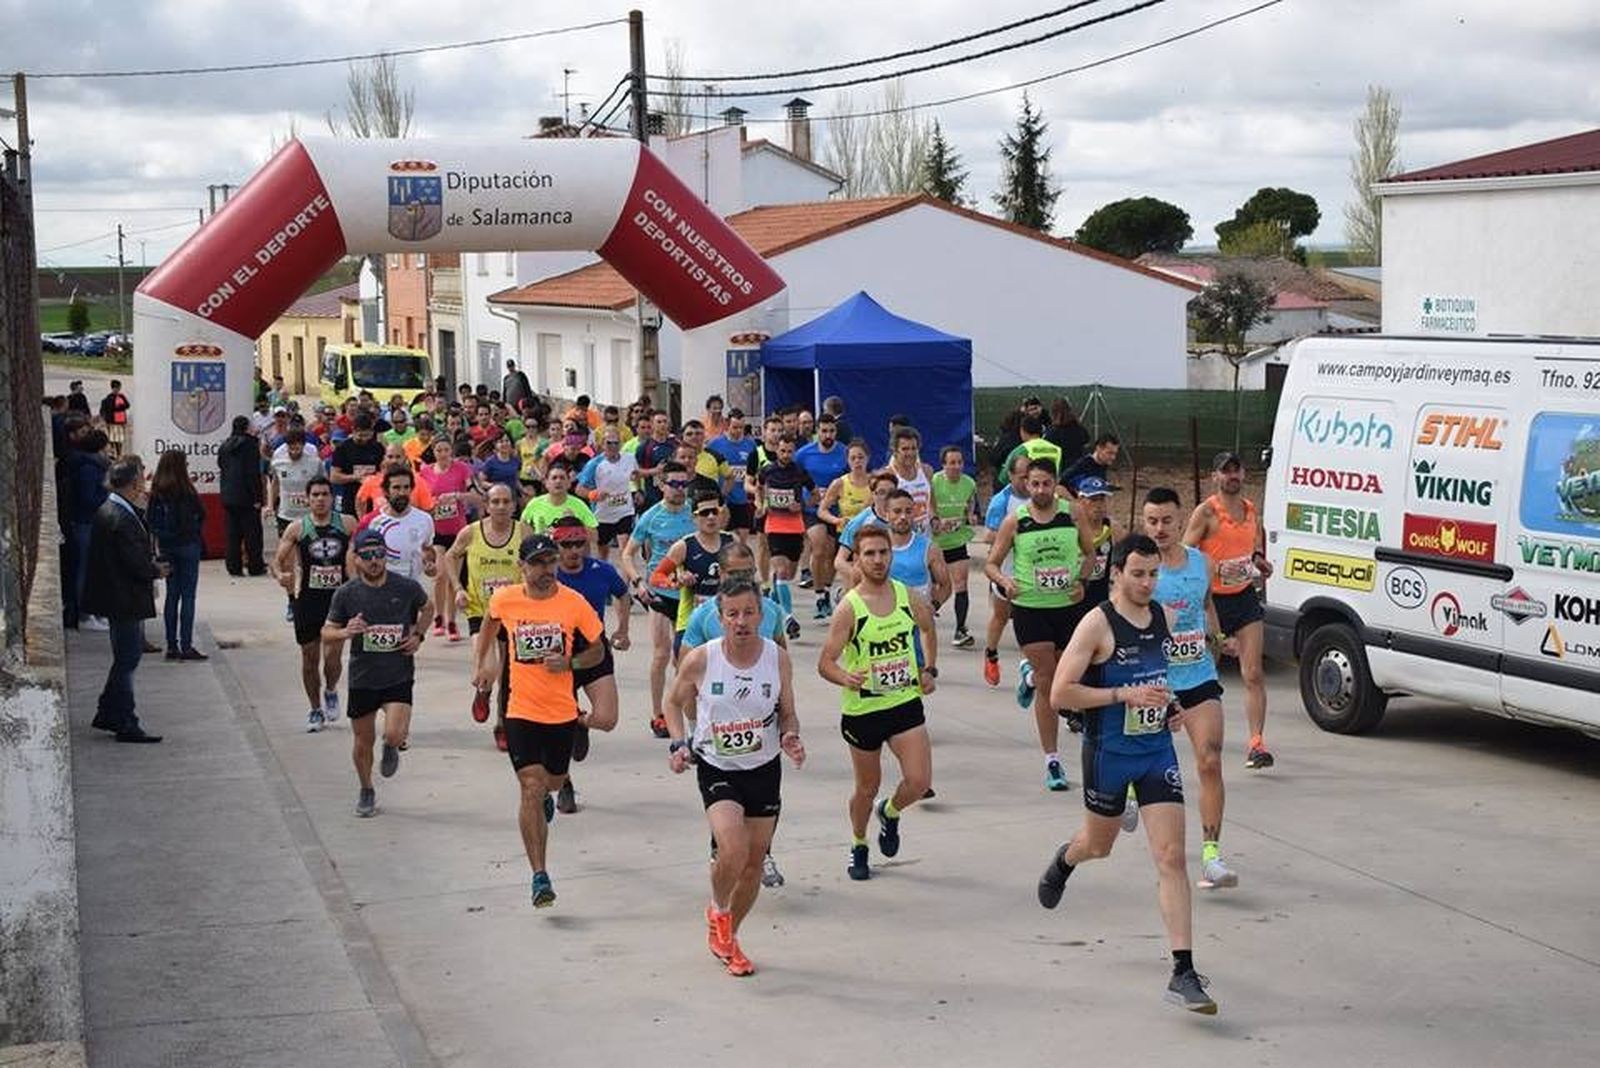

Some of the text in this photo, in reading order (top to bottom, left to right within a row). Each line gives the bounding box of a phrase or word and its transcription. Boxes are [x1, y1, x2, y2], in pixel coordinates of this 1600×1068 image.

[446, 171, 553, 193] Diputación
[446, 207, 573, 227] de Salamanca
[643, 189, 754, 296] CON NUESTROS
[197, 193, 330, 318] CON EL DEPORTE
[633, 212, 732, 307] DEPORTISTAS
[1318, 361, 1511, 387] www.campoyjardinveymaq.es
[1541, 369, 1578, 388] Tfno.
[1297, 406, 1393, 450] Kubota
[1417, 413, 1505, 451] STIHL
[1290, 466, 1384, 495] HONDA
[1414, 474, 1494, 507] VIKING
[1299, 503, 1381, 542] ETESIA
[1456, 538, 1489, 556] WOLF
[1291, 558, 1374, 583] pasquali
[1391, 577, 1422, 600] BCS
[372, 634, 396, 645] 263
[525, 636, 553, 650] 237
[1171, 641, 1198, 657] 205
[880, 669, 906, 686] 212
[722, 731, 754, 748] 239
